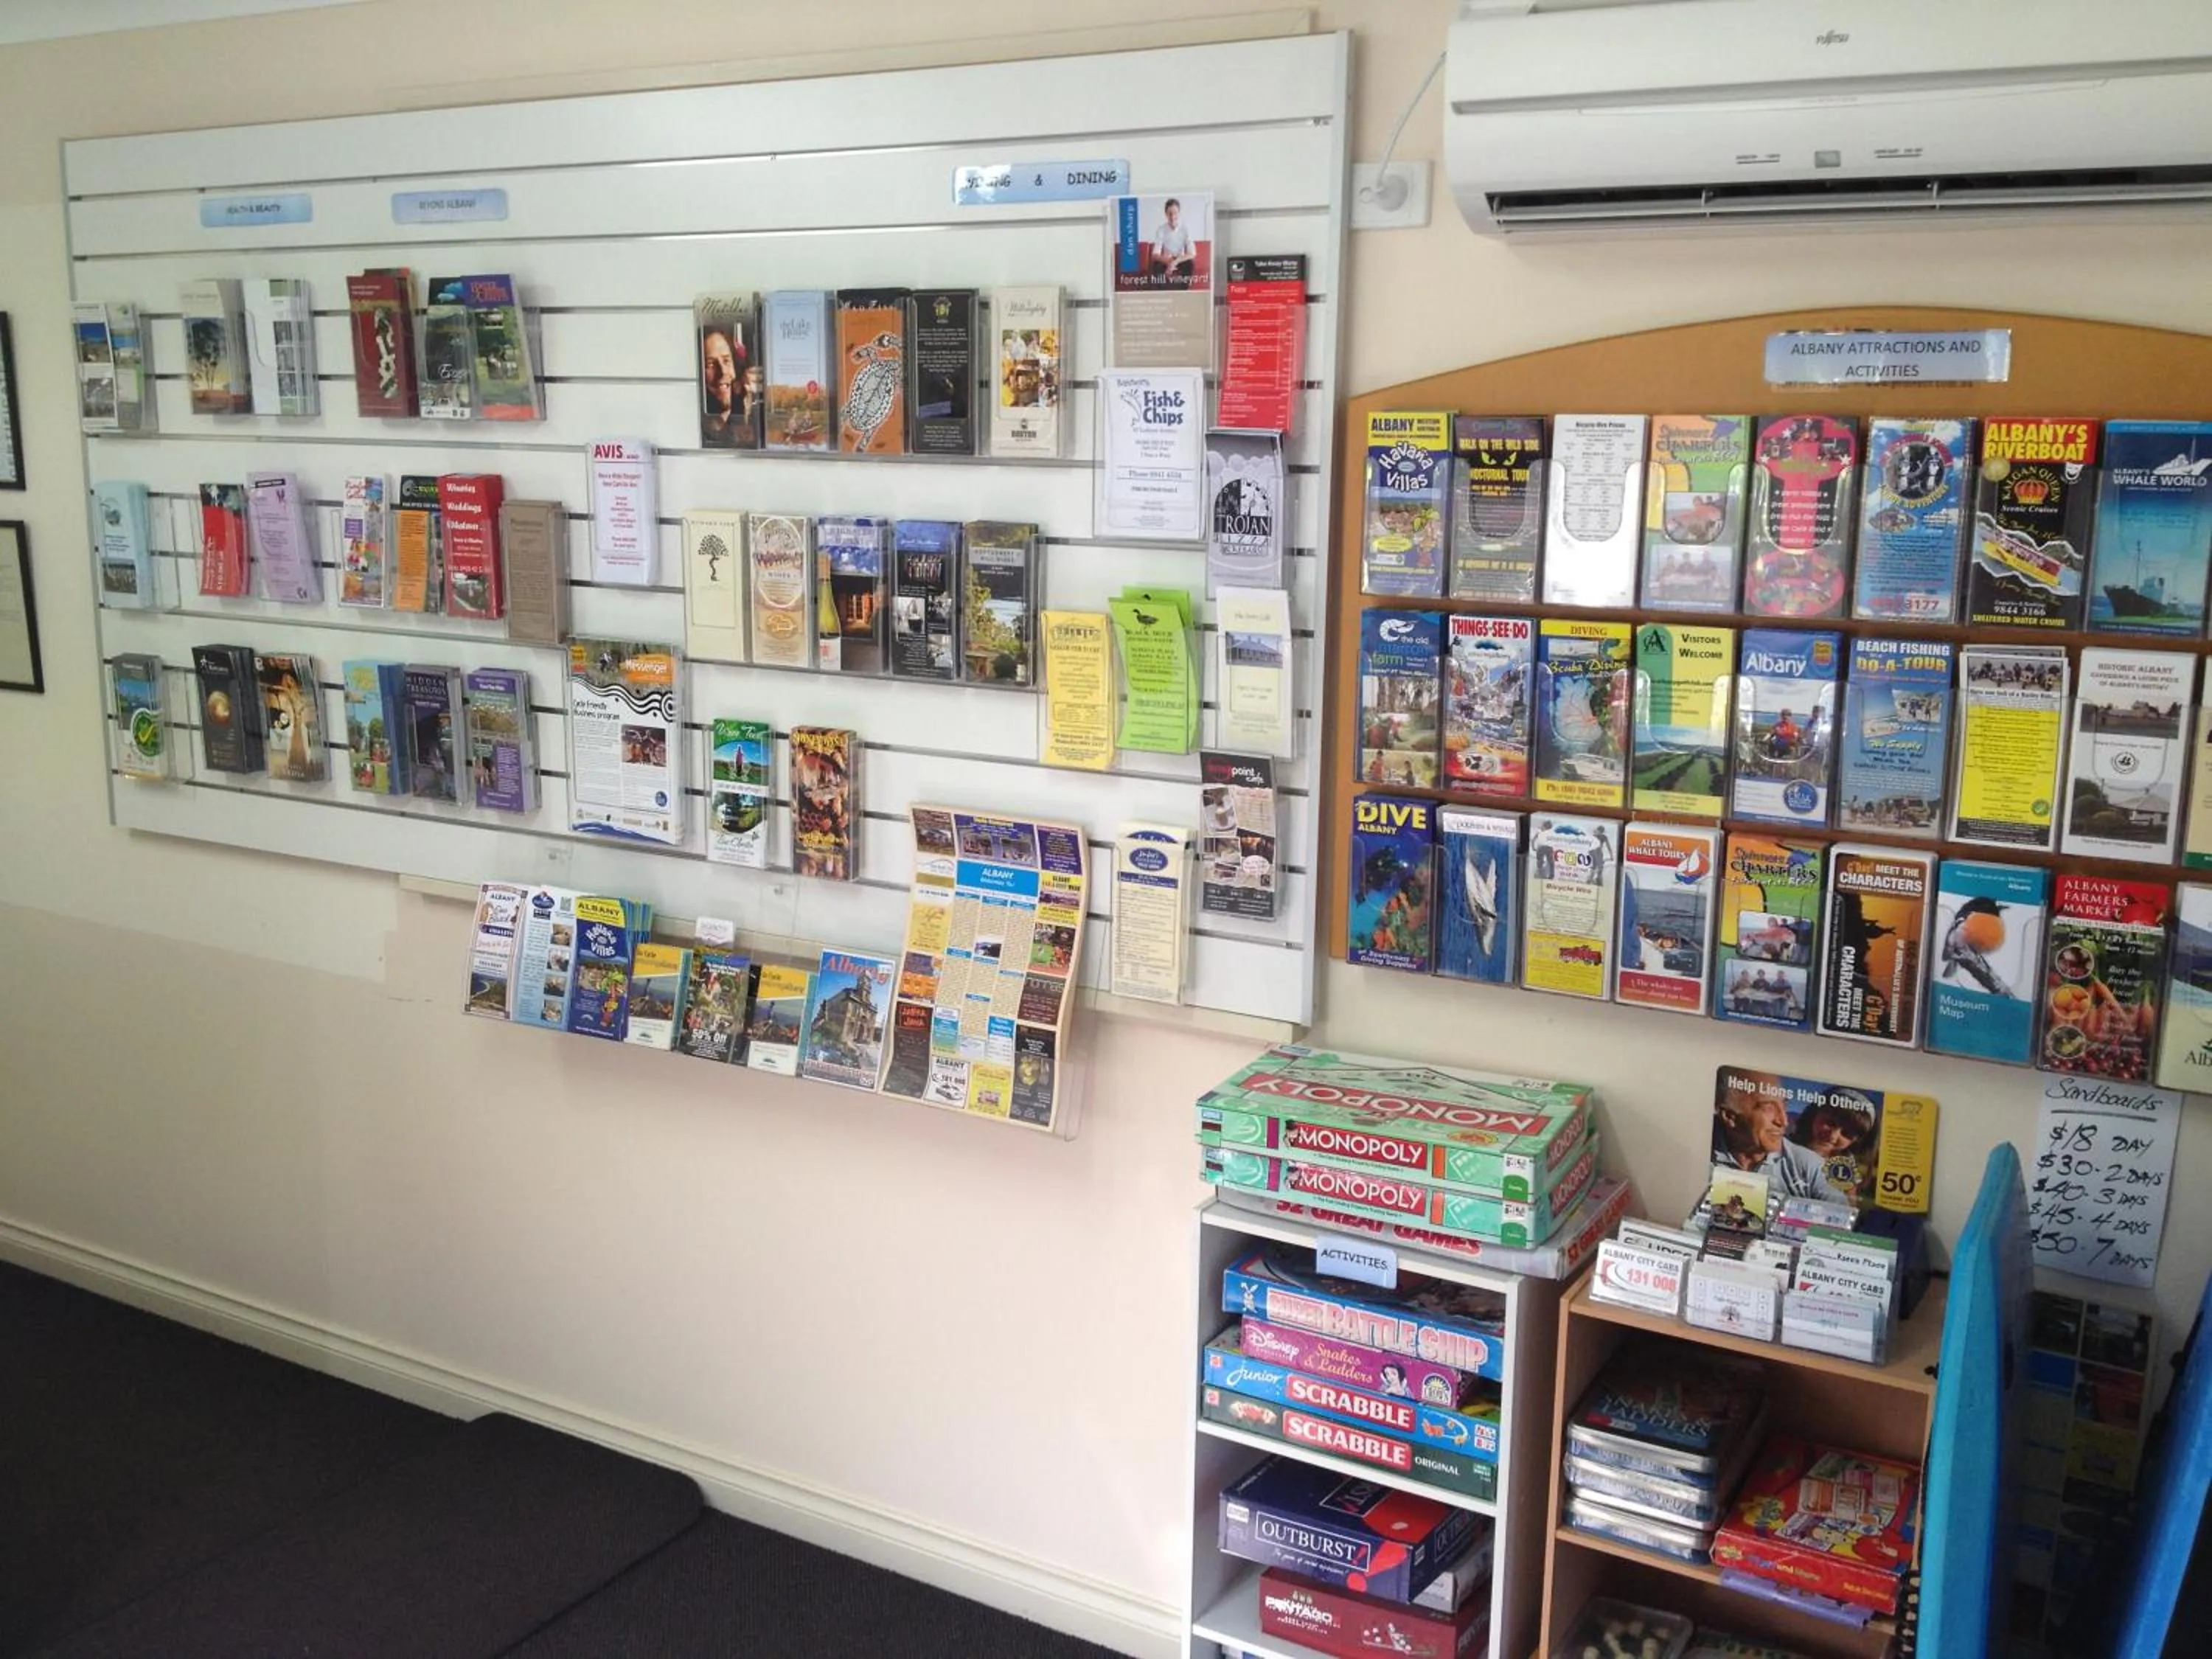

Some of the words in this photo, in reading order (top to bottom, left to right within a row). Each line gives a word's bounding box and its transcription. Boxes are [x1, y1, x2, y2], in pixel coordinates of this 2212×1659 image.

[1035, 175, 1043, 186] &
[1067, 171, 1117, 184] DINING
[1120, 274, 1148, 286] forest
[1150, 273, 1166, 285] hill
[1169, 273, 1211, 286] vineyard
[1791, 342, 1844, 355] ALBANY
[1847, 340, 1946, 355] ATTRACTIONS
[1949, 340, 1981, 353] AND
[1846, 365, 1919, 378] ACTIVITIES
[1143, 408, 1183, 426] Chips
[1371, 418, 1414, 432] ALBANY
[1985, 422, 2088, 443] ALBANY'S
[594, 444, 624, 459] AVIS
[1379, 442, 1433, 470] Havana
[1983, 442, 2087, 462] RIVERBOAT
[1386, 471, 1428, 492] Villas
[2112, 474, 2157, 487] WHALE
[2166, 475, 2208, 487] WORLD
[2001, 504, 2027, 513] Scenic
[1906, 600, 1939, 611] 3177
[1451, 618, 1489, 638] THINGS
[1491, 621, 1511, 638] SEE
[1512, 622, 1528, 639] DO
[1569, 625, 1608, 636] DIVING
[1400, 635, 1413, 644] the
[1414, 636, 1429, 645] old
[1681, 633, 1722, 645] VISITORS
[1856, 639, 1897, 653] BEACH
[1899, 641, 1951, 656] FISHING
[1679, 648, 1723, 660] WELCOME
[1745, 652, 1807, 677] Albany
[2138, 665, 2175, 674] ALBANY
[1231, 767, 1256, 777] point
[1355, 800, 1427, 830] DIVE
[1357, 824, 1398, 835] ALBANY
[1639, 838, 1674, 849] ALBANY
[1628, 846, 1658, 857] WHALE
[1659, 848, 1688, 860] TOURS
[1875, 863, 1901, 875] MEET
[1902, 866, 1920, 877] THE
[1838, 872, 1923, 892] CHARACTERS
[2064, 880, 2121, 894] ALBANY
[2064, 891, 2129, 907] FARMERS
[577, 902, 621, 917] ALBANY
[2063, 903, 2122, 918] MARKET
[1836, 945, 1857, 1028] CHARACTERS
[1940, 993, 1990, 1012] Museum
[1938, 1005, 1965, 1020] Map
[1728, 1076, 1756, 1094] Help
[1759, 1082, 1794, 1101] Lions
[1797, 1088, 1826, 1107] Help
[1829, 1093, 1875, 1113] Others
[2045, 1077, 2163, 1111] Sandboards
[1253, 1077, 1537, 1134] MONOPOLY
[1298, 1126, 1423, 1164] MONOPOLY
[2050, 1121, 2098, 1152] $18
[2111, 1135, 2156, 1157] DAY
[2126, 1168, 2164, 1187] DAYS
[1298, 1169, 1422, 1210] MONOPOLY
[2116, 1192, 2149, 1207] DAYS
[2114, 1219, 2152, 1236] DAYS
[1321, 1248, 1388, 1271] ACTIVITIES
[1603, 1248, 1635, 1263] ALBANY
[1636, 1254, 1655, 1267] CITY
[1657, 1259, 1680, 1273] CABS
[2087, 1237, 2116, 1266] 7
[2109, 1251, 2154, 1270] DAYS
[1626, 1267, 1649, 1284] 131
[1801, 1269, 1835, 1284] ALBANY
[1837, 1277, 1859, 1289] CITY
[1860, 1283, 1885, 1295] CABS
[1245, 1324, 1300, 1360] Disney
[1326, 1302, 1418, 1354] BATTLE
[1418, 1326, 1489, 1372] SHIP
[1316, 1342, 1362, 1366] Snakes
[1318, 1358, 1374, 1385] Ladders
[1226, 1364, 1282, 1387] Junior
[1292, 1380, 1411, 1429] SCRABBLE
[1287, 1416, 1408, 1466] SCRABBLE
[1414, 1455, 1461, 1476] ORIGINAL
[1261, 1520, 1367, 1566] OUTBURST!
